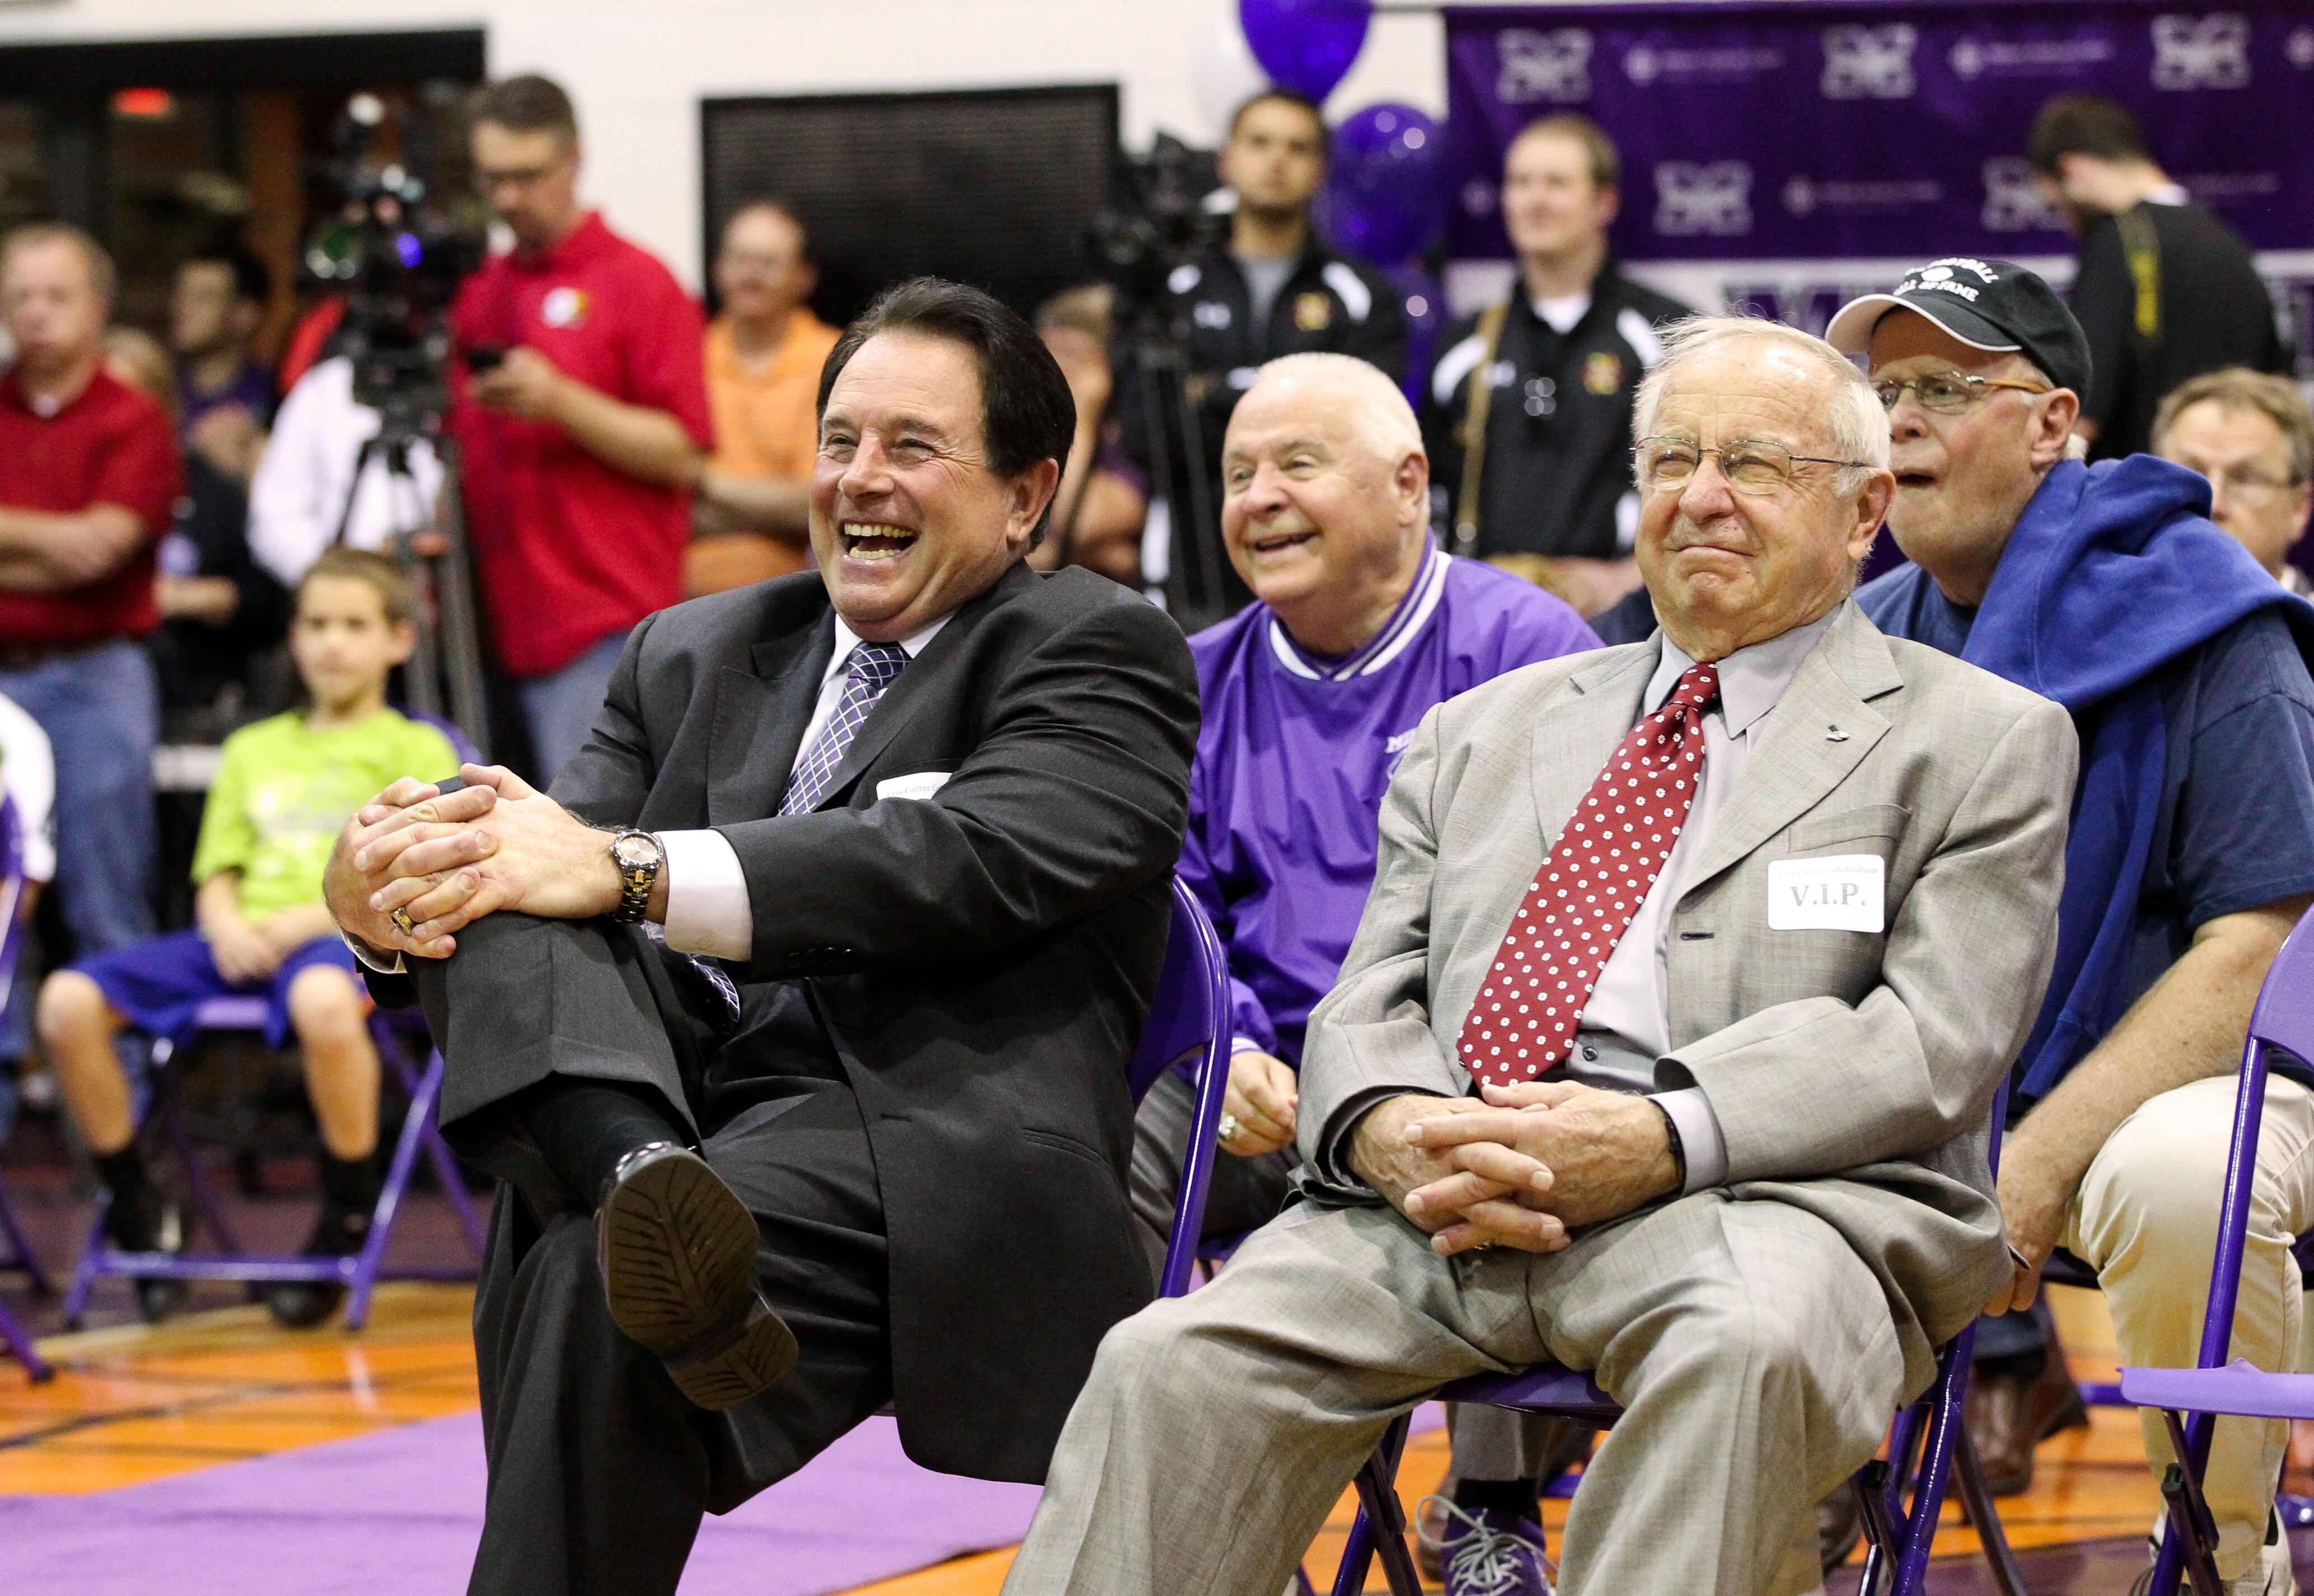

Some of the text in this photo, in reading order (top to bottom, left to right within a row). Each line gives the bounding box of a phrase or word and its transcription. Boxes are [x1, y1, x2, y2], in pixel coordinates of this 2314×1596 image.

[905, 785, 931, 794] Carter
[1827, 866, 1879, 874] Celebration
[1790, 883, 1866, 907] V.I.P.
